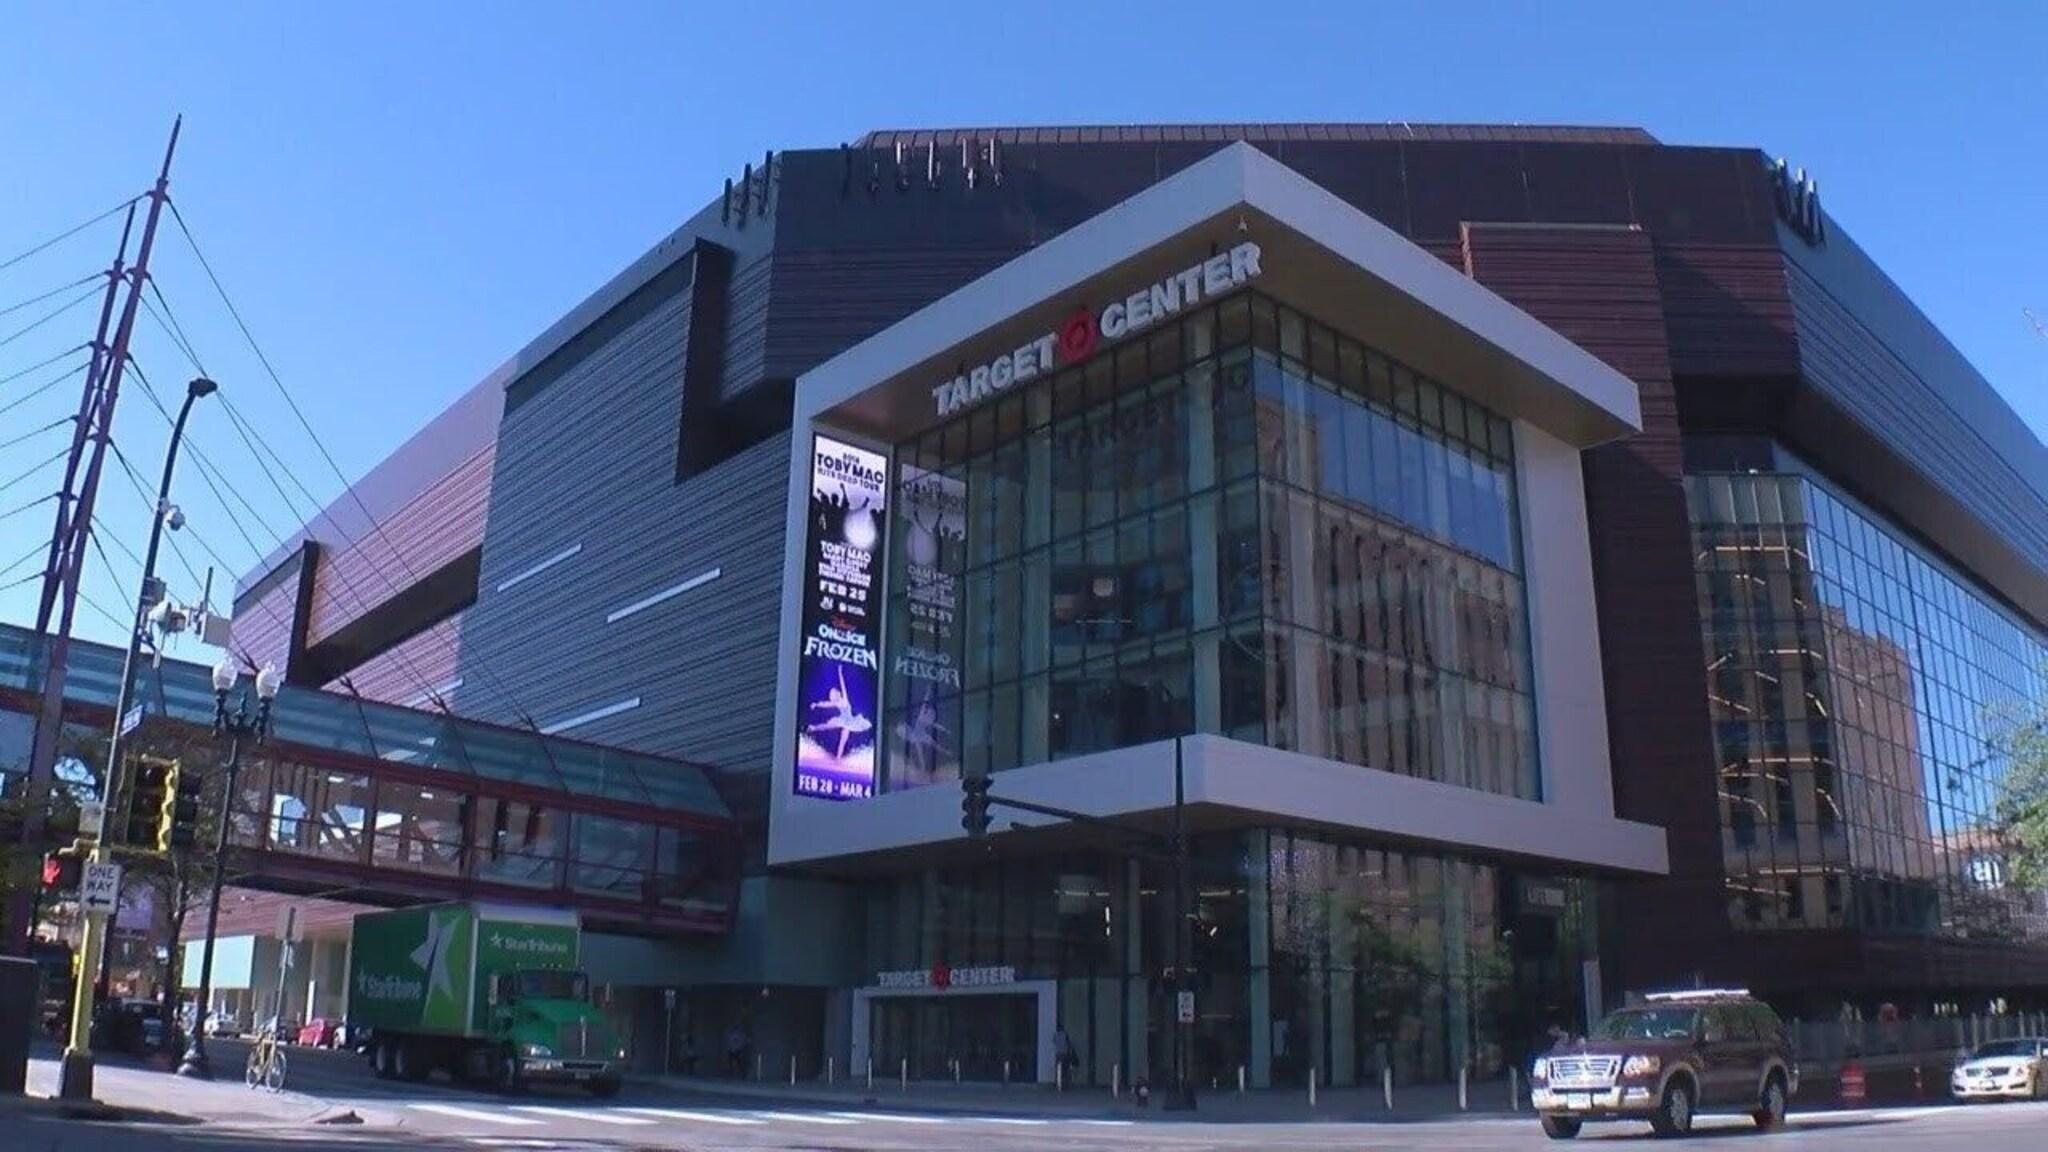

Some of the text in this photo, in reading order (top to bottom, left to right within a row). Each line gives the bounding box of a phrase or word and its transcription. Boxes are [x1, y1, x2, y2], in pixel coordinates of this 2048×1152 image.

[933, 241, 1263, 418] TARGET CENTER
[820, 580, 847, 597] FEB
[804, 636, 878, 671] FROZEN
[799, 774, 819, 792] FEB
[840, 781, 863, 798] MAR
[864, 785, 872, 799] 4
[87, 865, 115, 880] ONE
[86, 881, 113, 892] WAY
[876, 966, 1016, 988] TARGET CENTER
